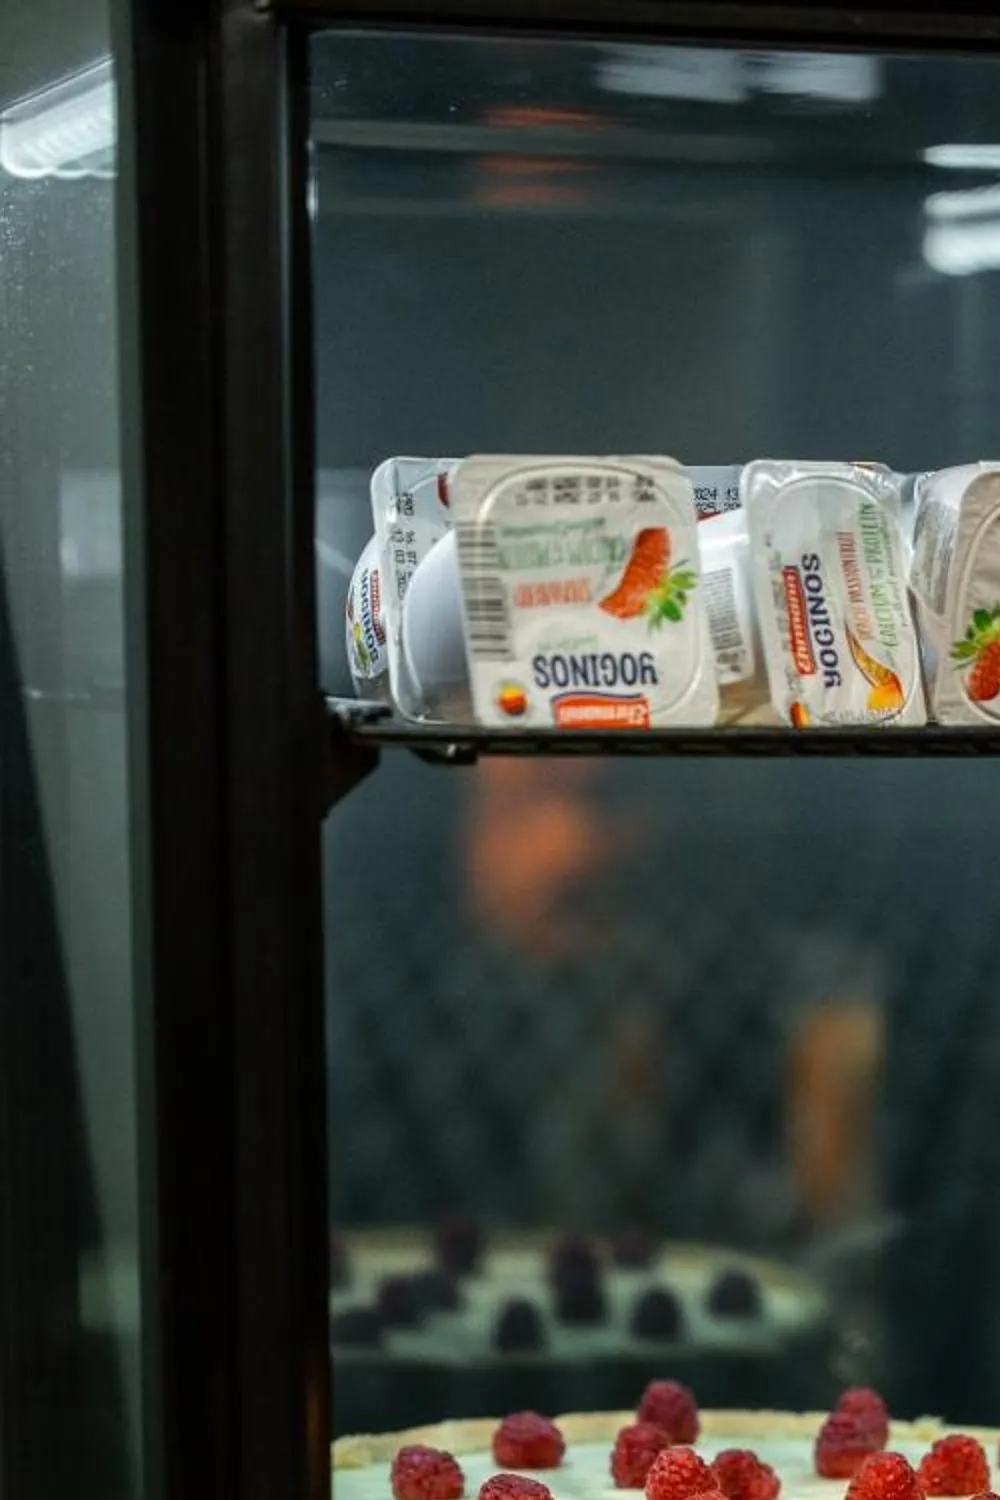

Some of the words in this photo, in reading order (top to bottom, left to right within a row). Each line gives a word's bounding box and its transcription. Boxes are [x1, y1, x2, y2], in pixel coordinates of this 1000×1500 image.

[857, 501, 883, 565] PROTEIN
[784, 571, 814, 673] Ehrmann
[802, 552, 842, 689] YOGINOS
[533, 652, 660, 689] YOGINOS
